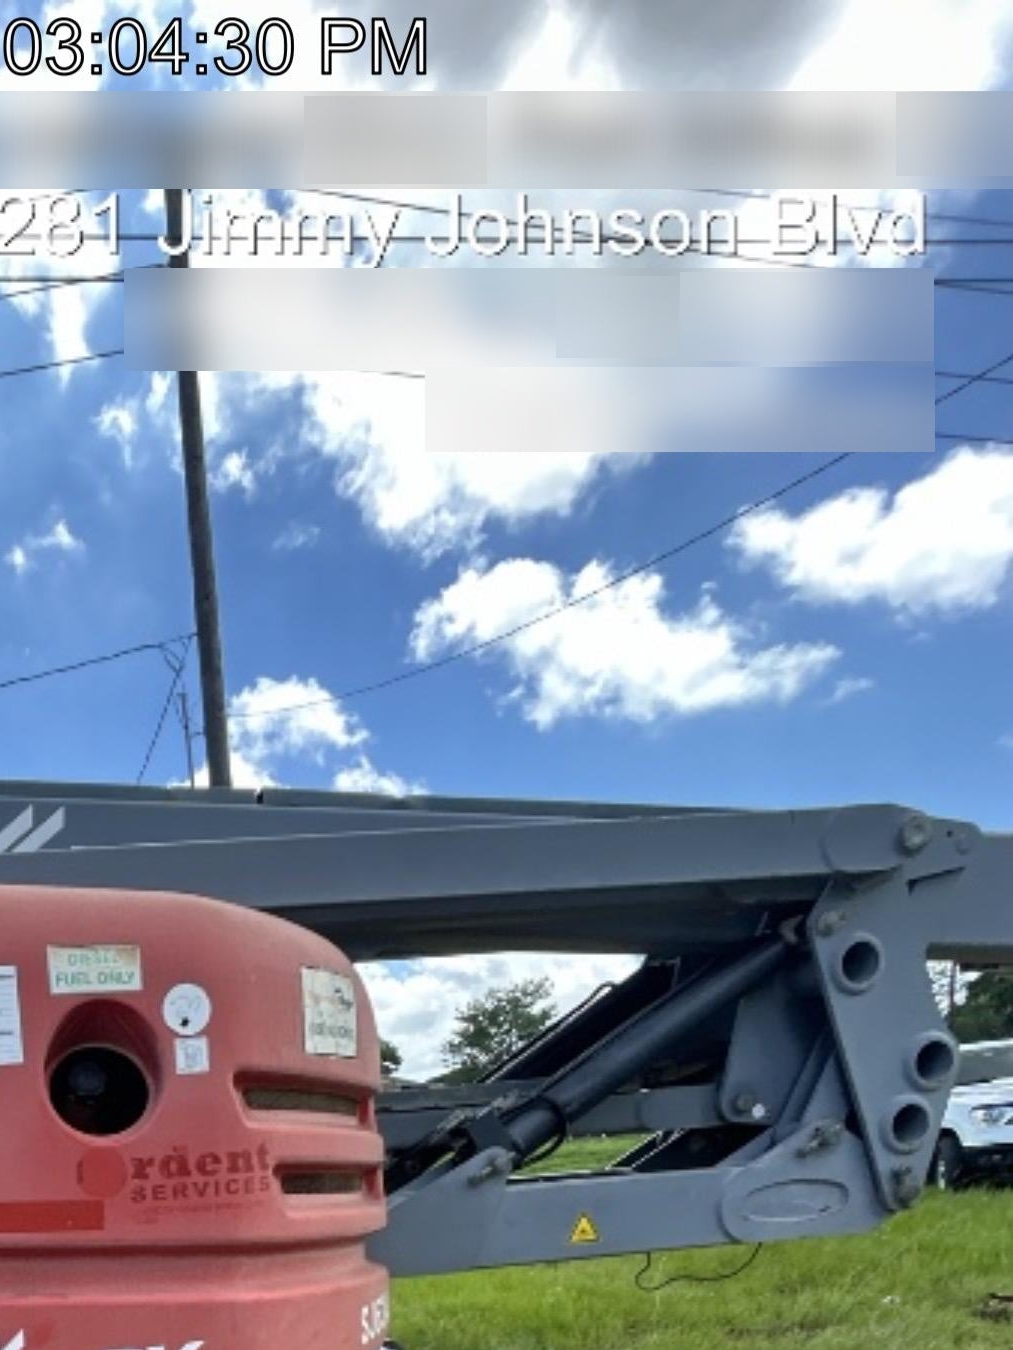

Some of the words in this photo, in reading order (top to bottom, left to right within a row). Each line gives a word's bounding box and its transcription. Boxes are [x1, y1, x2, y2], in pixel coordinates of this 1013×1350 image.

[54, 970, 92, 988] FUEL
[96, 969, 135, 986] ONLY
[130, 1176, 270, 1203] SERVICES
